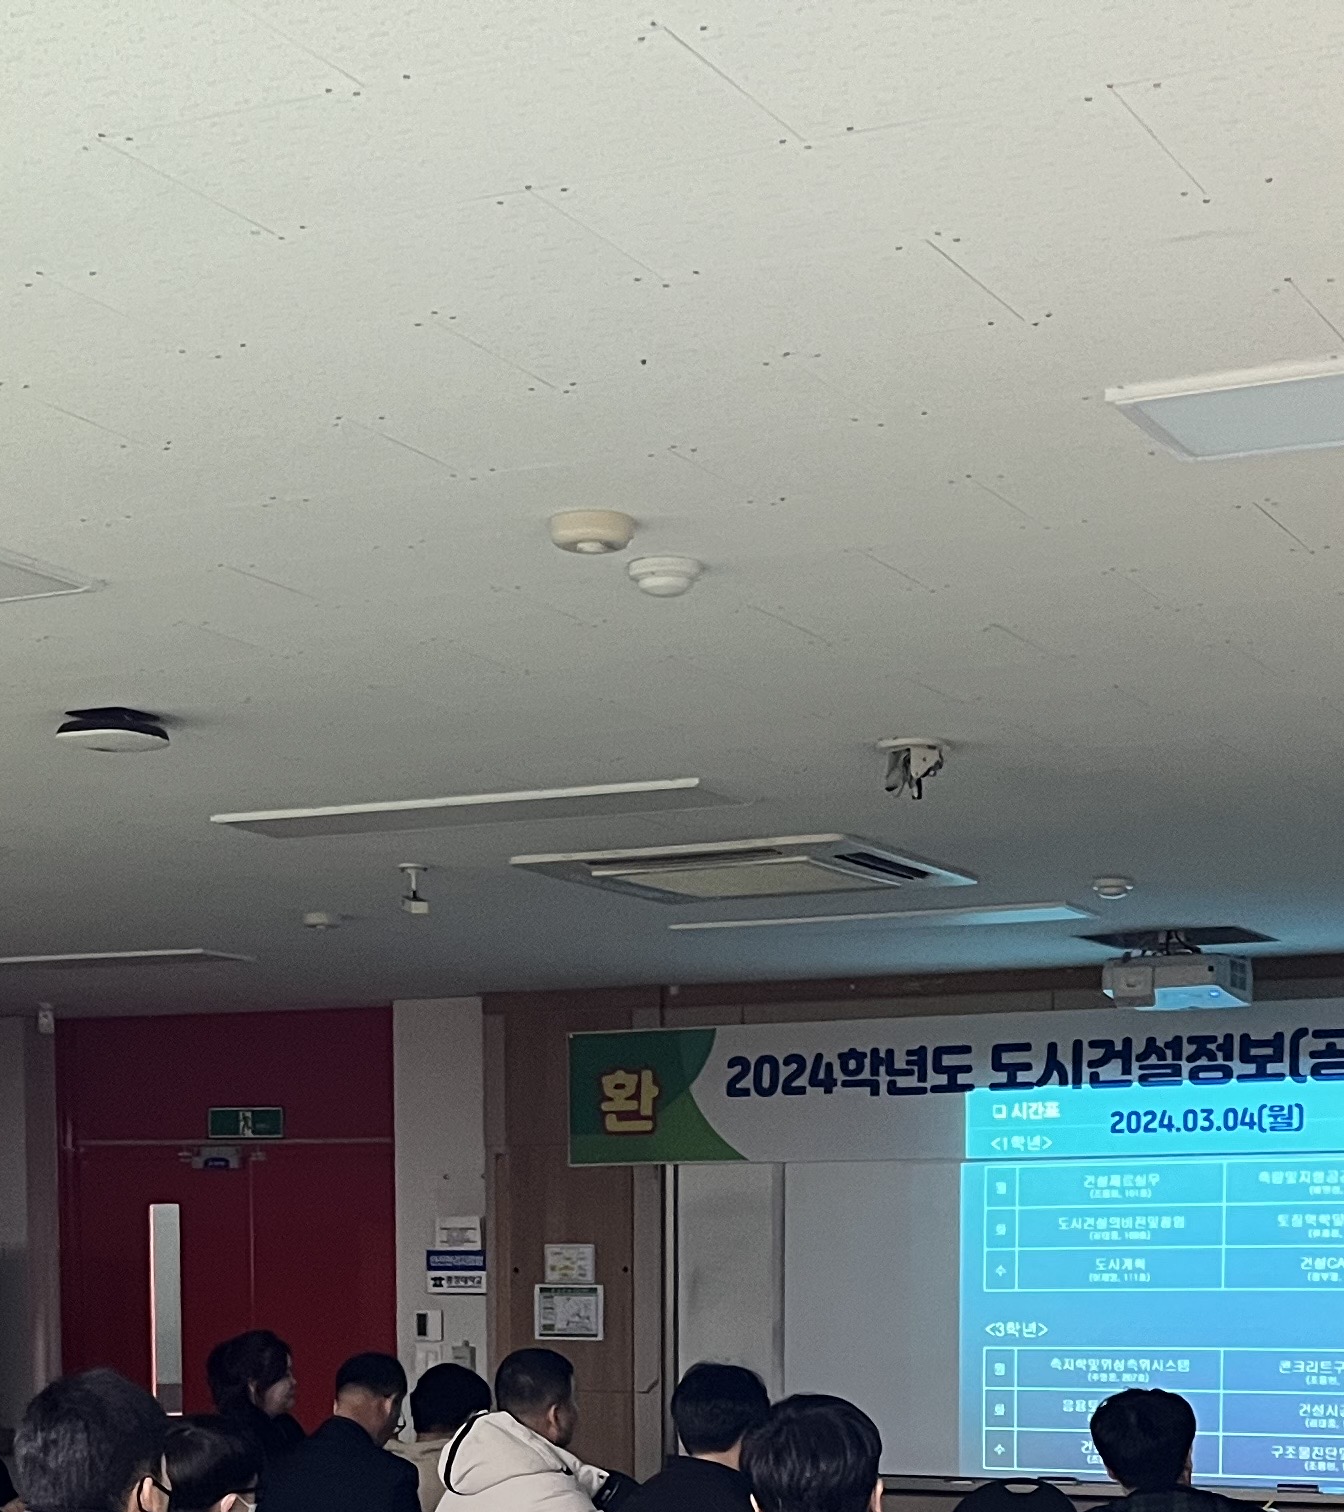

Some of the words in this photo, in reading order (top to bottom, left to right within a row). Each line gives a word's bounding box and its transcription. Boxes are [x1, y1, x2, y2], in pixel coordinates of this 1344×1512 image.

[725, 1043, 975, 1098] 2024학년도
[599, 1067, 660, 1136] 환
[1011, 1101, 1060, 1119] 시간표
[1109, 1103, 1305, 1135] 2024.03.04(월)
[990, 1135, 1053, 1152] <1학년>
[984, 1321, 1048, 1338] <3학년>
